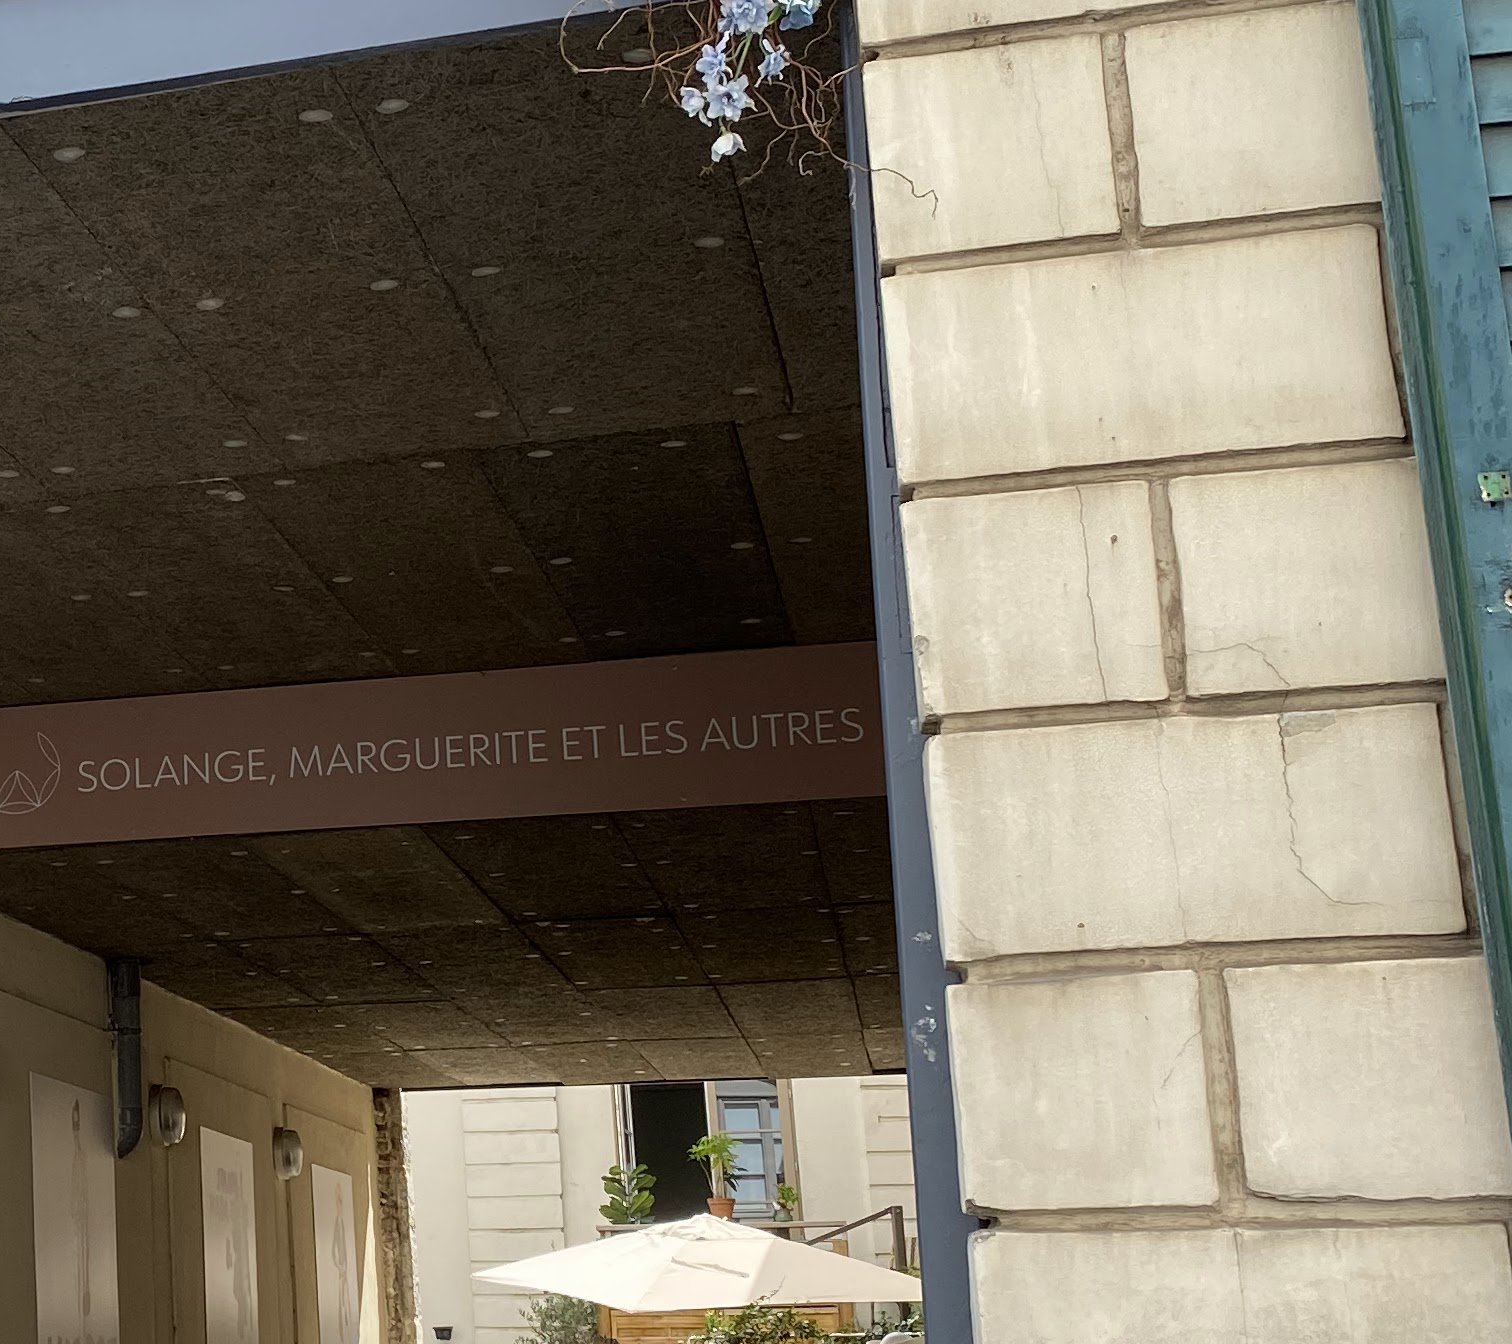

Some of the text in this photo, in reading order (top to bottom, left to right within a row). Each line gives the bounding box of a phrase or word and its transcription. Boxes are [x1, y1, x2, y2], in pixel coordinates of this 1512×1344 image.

[77, 707, 865, 794] SOLANGE, MARGUERITE ET LES AUTRES
